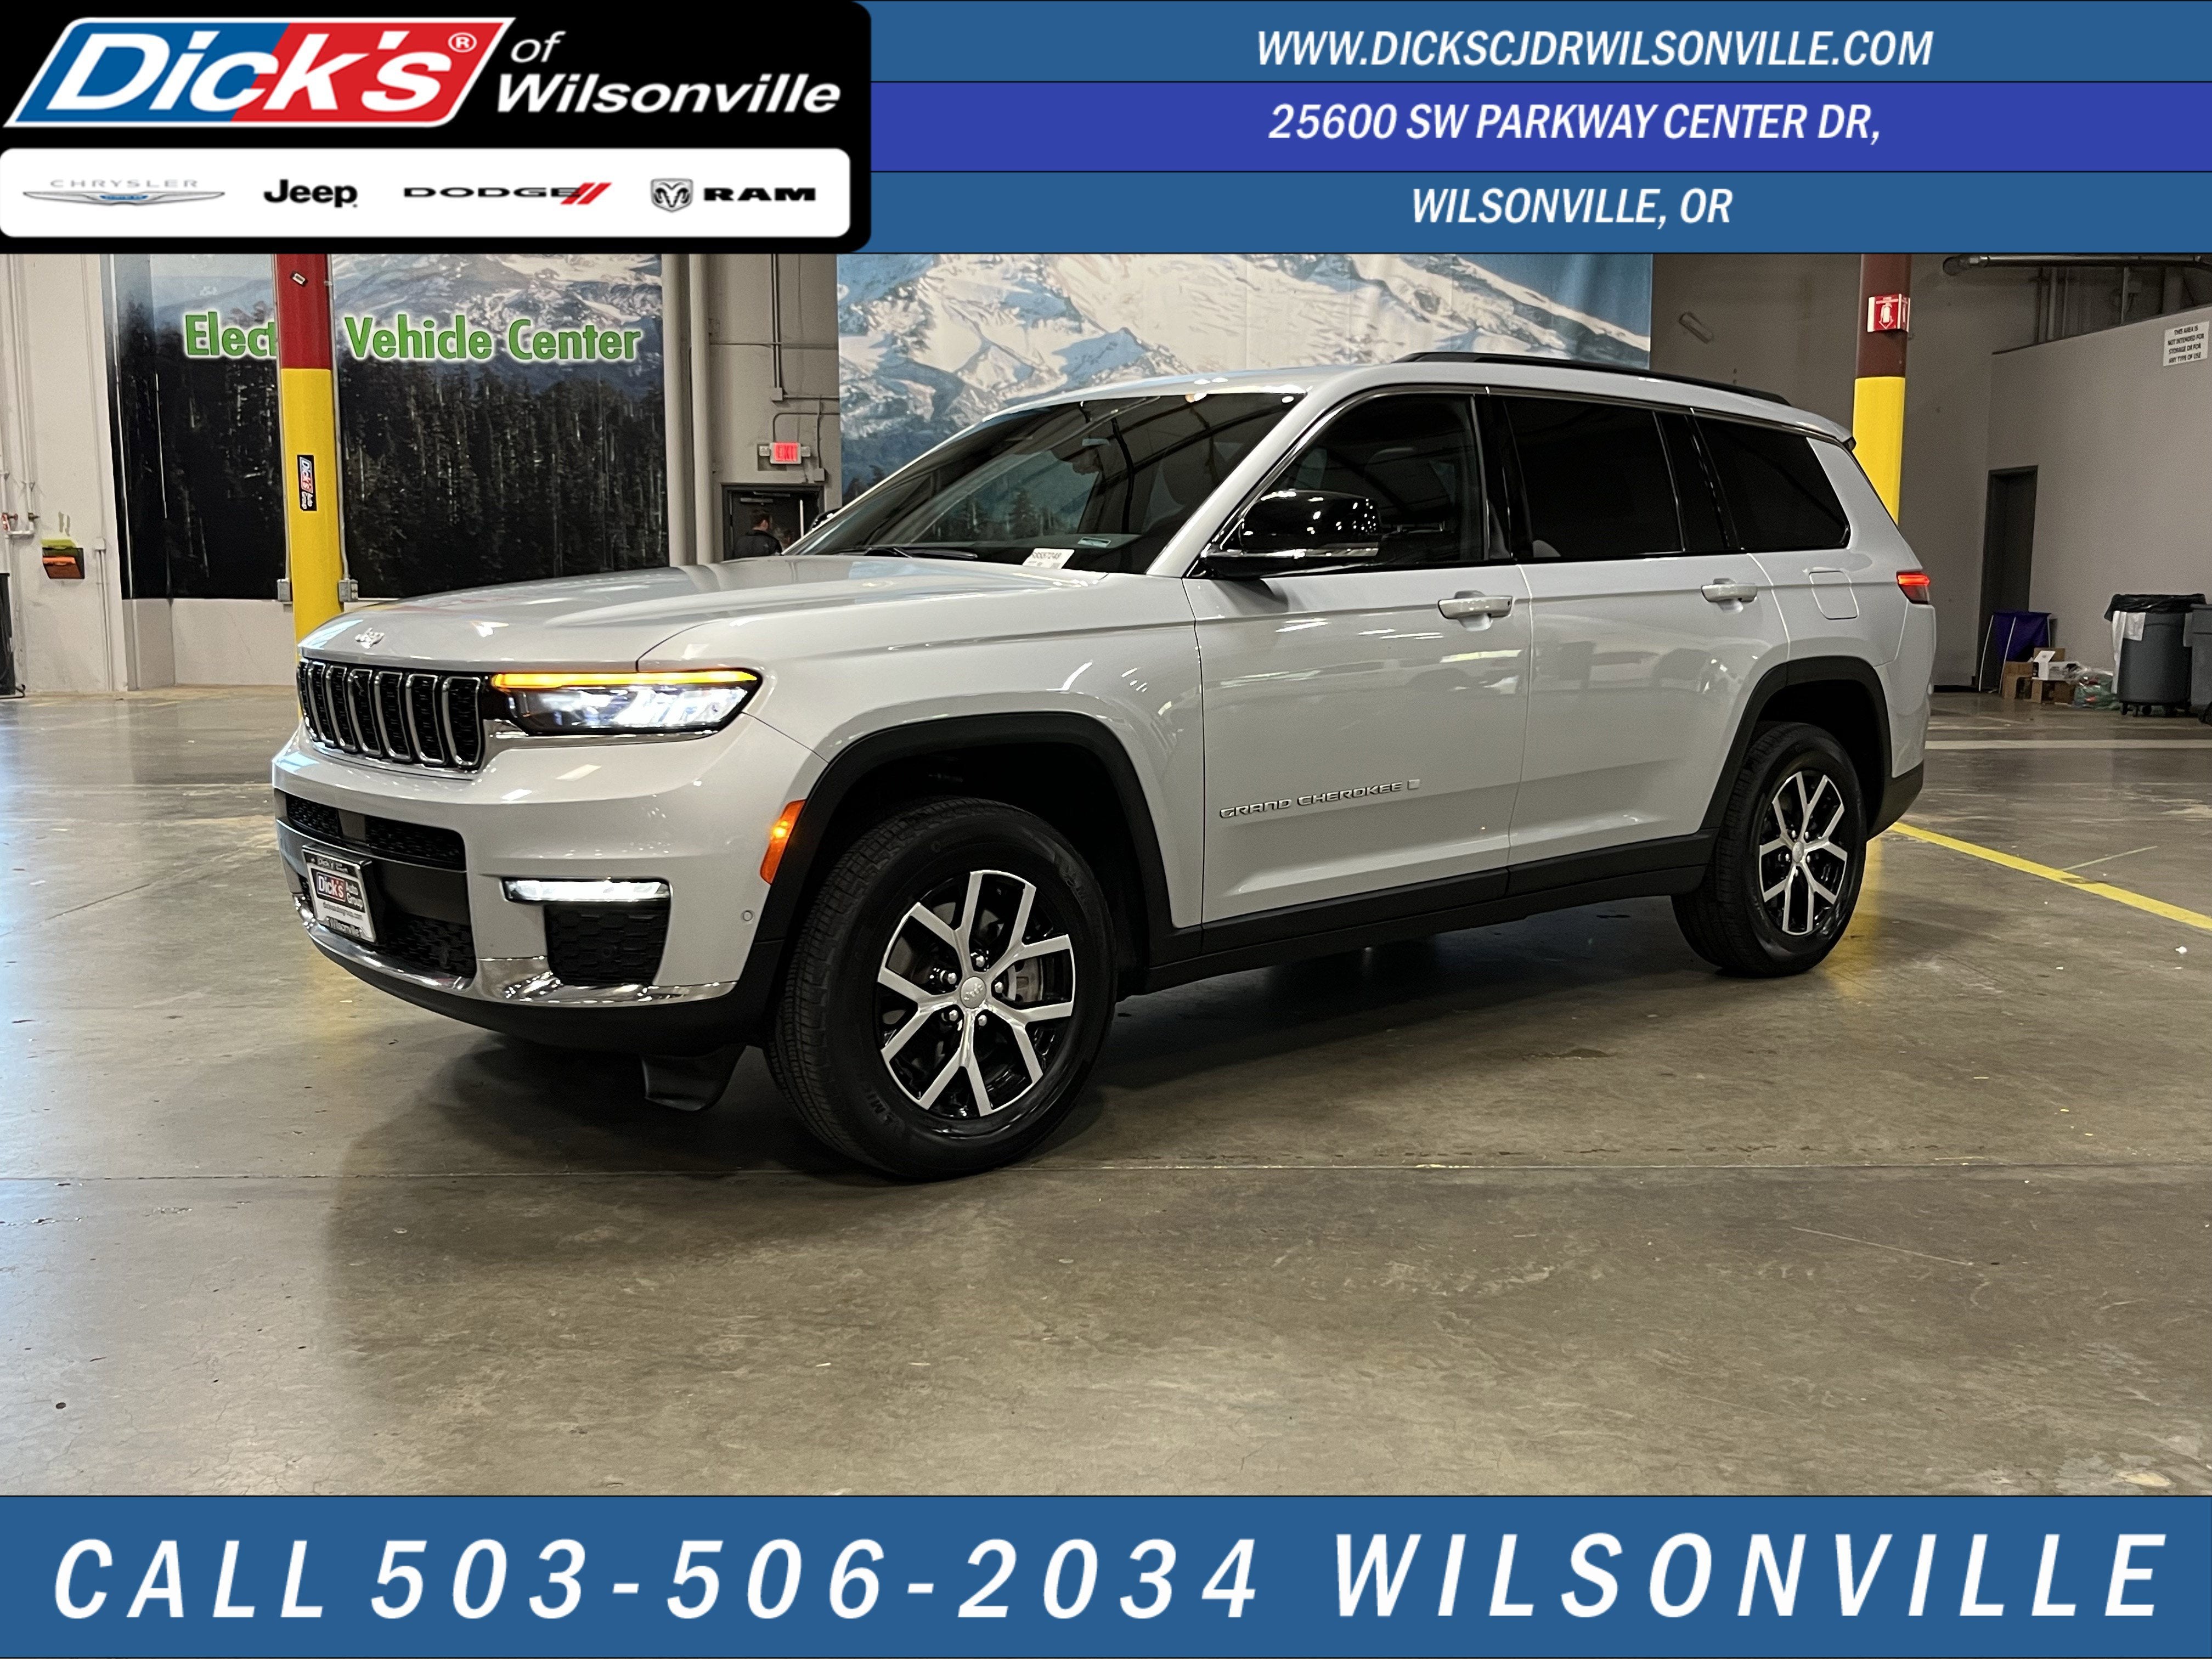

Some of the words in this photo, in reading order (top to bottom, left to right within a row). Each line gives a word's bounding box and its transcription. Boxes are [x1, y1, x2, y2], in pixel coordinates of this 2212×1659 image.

[345, 314, 492, 359] Vehicle
[508, 318, 642, 360] Center
[776, 445, 798, 460] EXIT
[1219, 798, 1293, 819] GRAND
[1297, 781, 1403, 806] CHEROKEE
